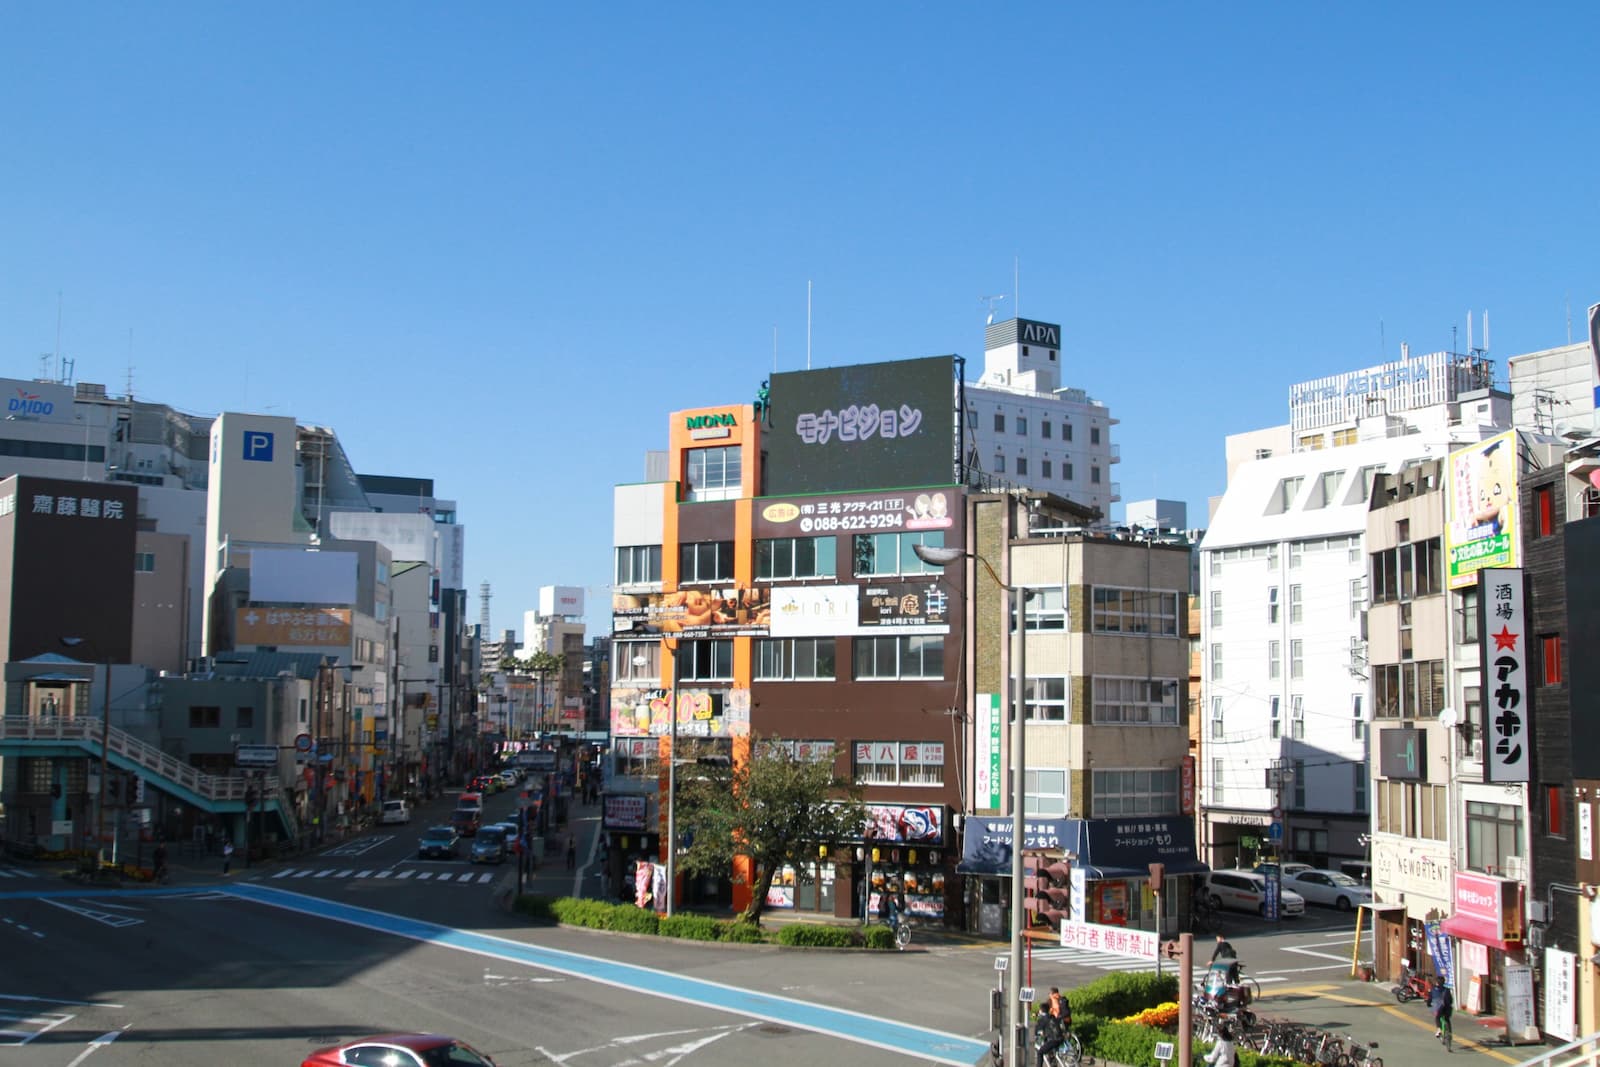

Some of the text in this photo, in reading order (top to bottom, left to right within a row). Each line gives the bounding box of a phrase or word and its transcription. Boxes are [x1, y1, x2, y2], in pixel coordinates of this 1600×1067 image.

[1024, 324, 1056, 344] APA
[1295, 364, 1428, 403] HOTEL ASTORIA
[8, 399, 54, 415] DAIDO
[686, 413, 736, 430] MONA
[796, 403, 922, 444] モナビジョン
[250, 435, 269, 457] P
[817, 502, 841, 514] 三光
[843, 501, 883, 513] アクティ21
[887, 499, 902, 510] 1F
[814, 514, 902, 531] 088-622-9294
[801, 601, 849, 616] IORI
[880, 606, 892, 615] iori
[900, 593, 920, 616] 庵
[1496, 584, 1514, 621] 酒場
[1494, 656, 1522, 765] アカホシ
[1037, 836, 1059, 848] もり
[1114, 834, 1172, 847] フードショップ もり
[1064, 925, 1154, 957] 歩行者 横断禁止
